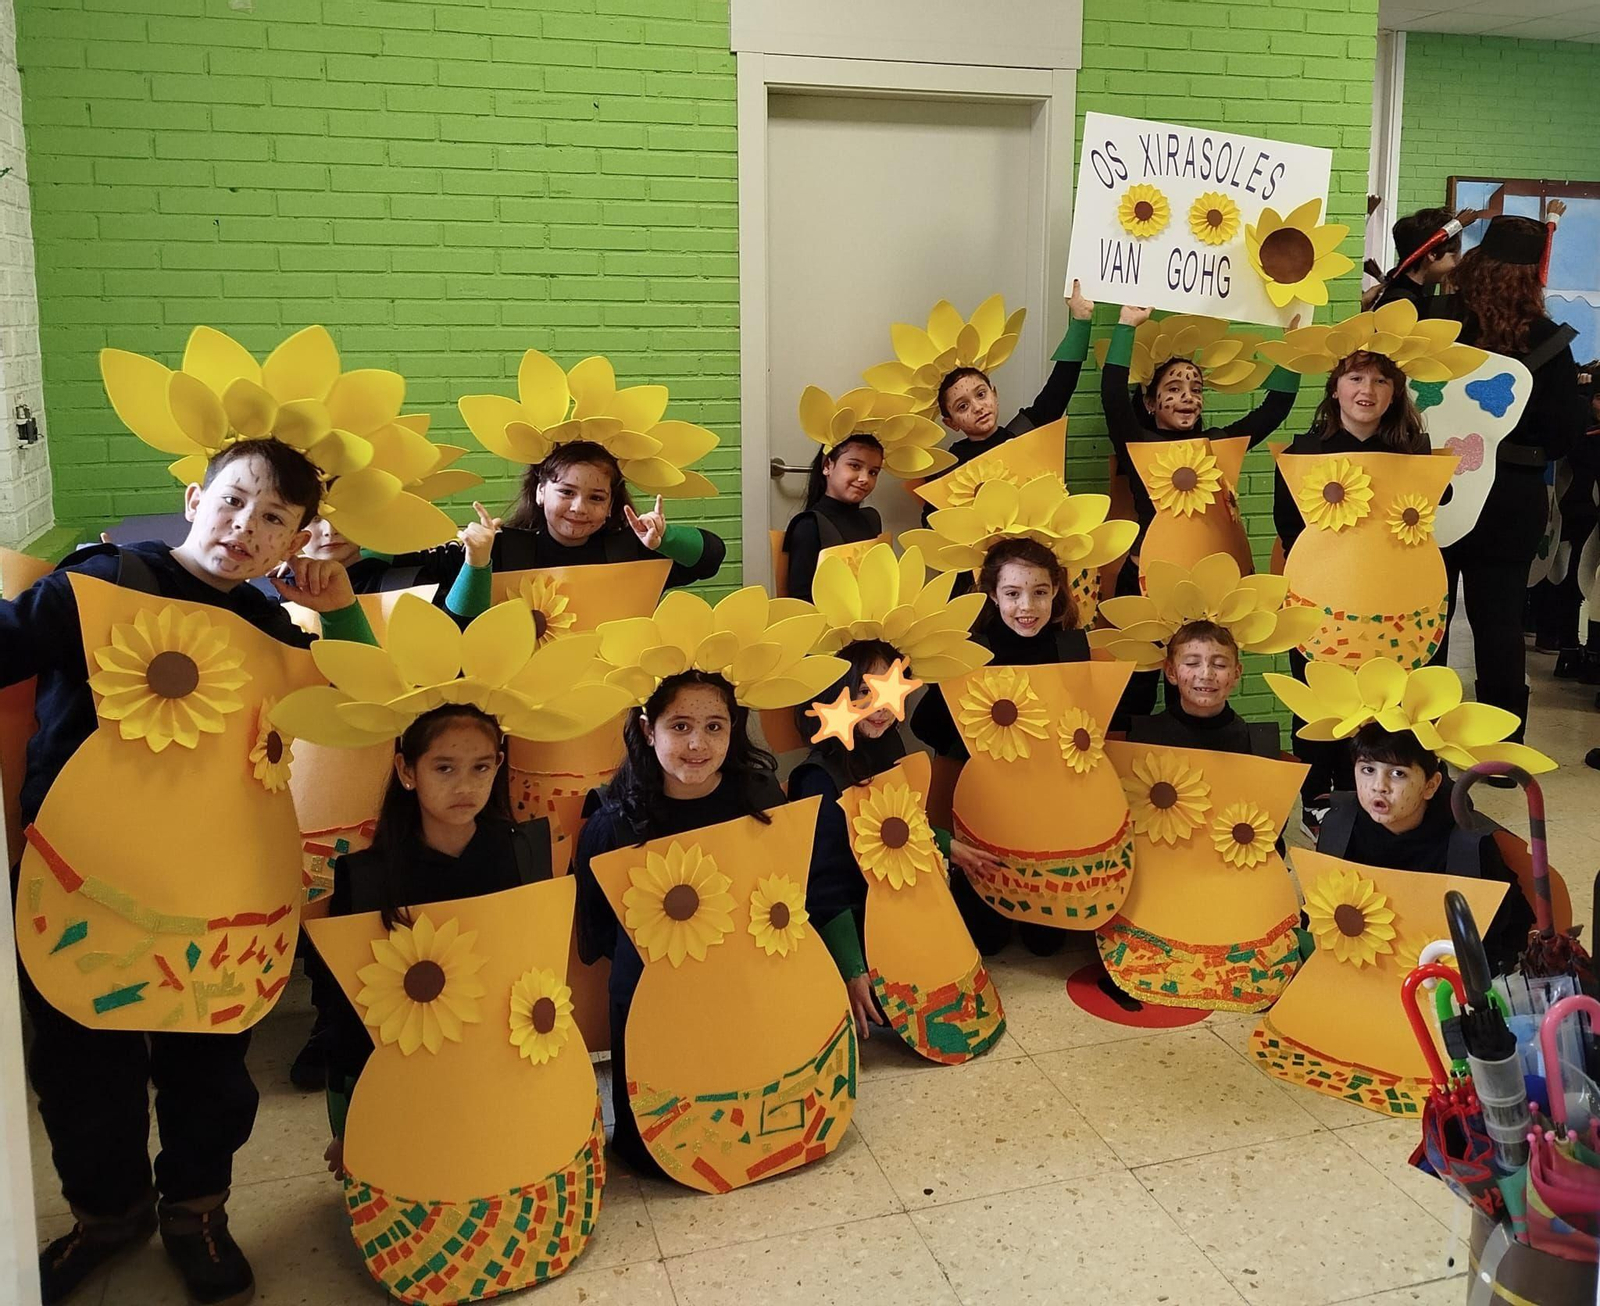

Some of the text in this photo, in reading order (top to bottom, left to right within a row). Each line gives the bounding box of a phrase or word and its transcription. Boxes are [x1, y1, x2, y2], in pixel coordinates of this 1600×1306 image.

[1091, 133, 1285, 200] OS XIRASOLES
[1100, 238, 1231, 298] VAN GOHG
